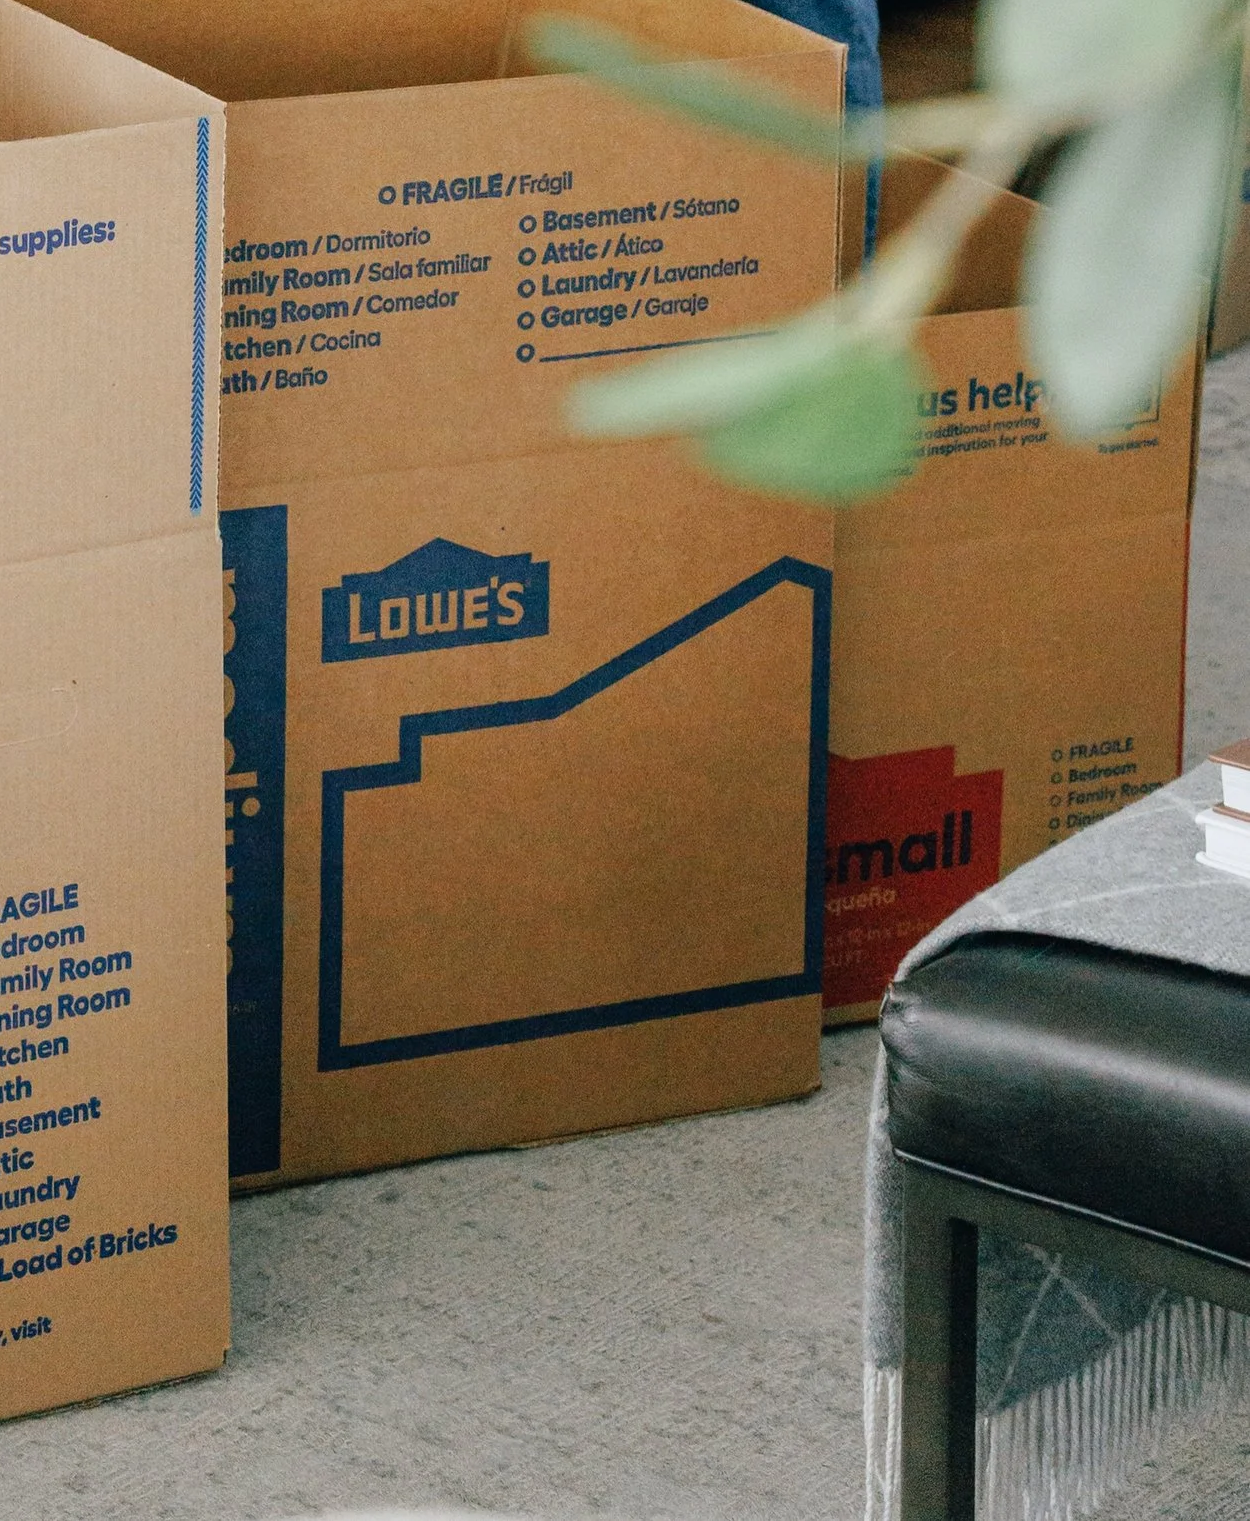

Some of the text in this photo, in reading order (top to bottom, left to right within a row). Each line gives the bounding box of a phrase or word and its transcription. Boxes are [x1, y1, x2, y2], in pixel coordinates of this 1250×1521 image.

[402, 171, 573, 206] FRAGILE Frágil
[543, 197, 740, 233] Basement Sótano
[223, 226, 431, 265] droom Dormitorio
[541, 233, 664, 265] Attic Ático
[221, 253, 492, 297] mily Room Sala familiar
[542, 255, 759, 297] Laundry Lavandería
[220, 288, 460, 331] ning Room Comedor
[540, 293, 709, 329] Garage Garaje
[220, 329, 381, 365] tchen Cocina
[219, 366, 328, 400] th Baño
[349, 576, 525, 644] LOWE'S
[1070, 737, 1133, 760] FRAGILE
[1069, 763, 1137, 783] Bedroom
[826, 886, 896, 916] queña
[59, 951, 132, 983] Room
[57, 987, 131, 1020] Room
[66, 1235, 97, 1266] of
[98, 1223, 179, 1259] Bricks
[10, 1316, 52, 1341] visit
